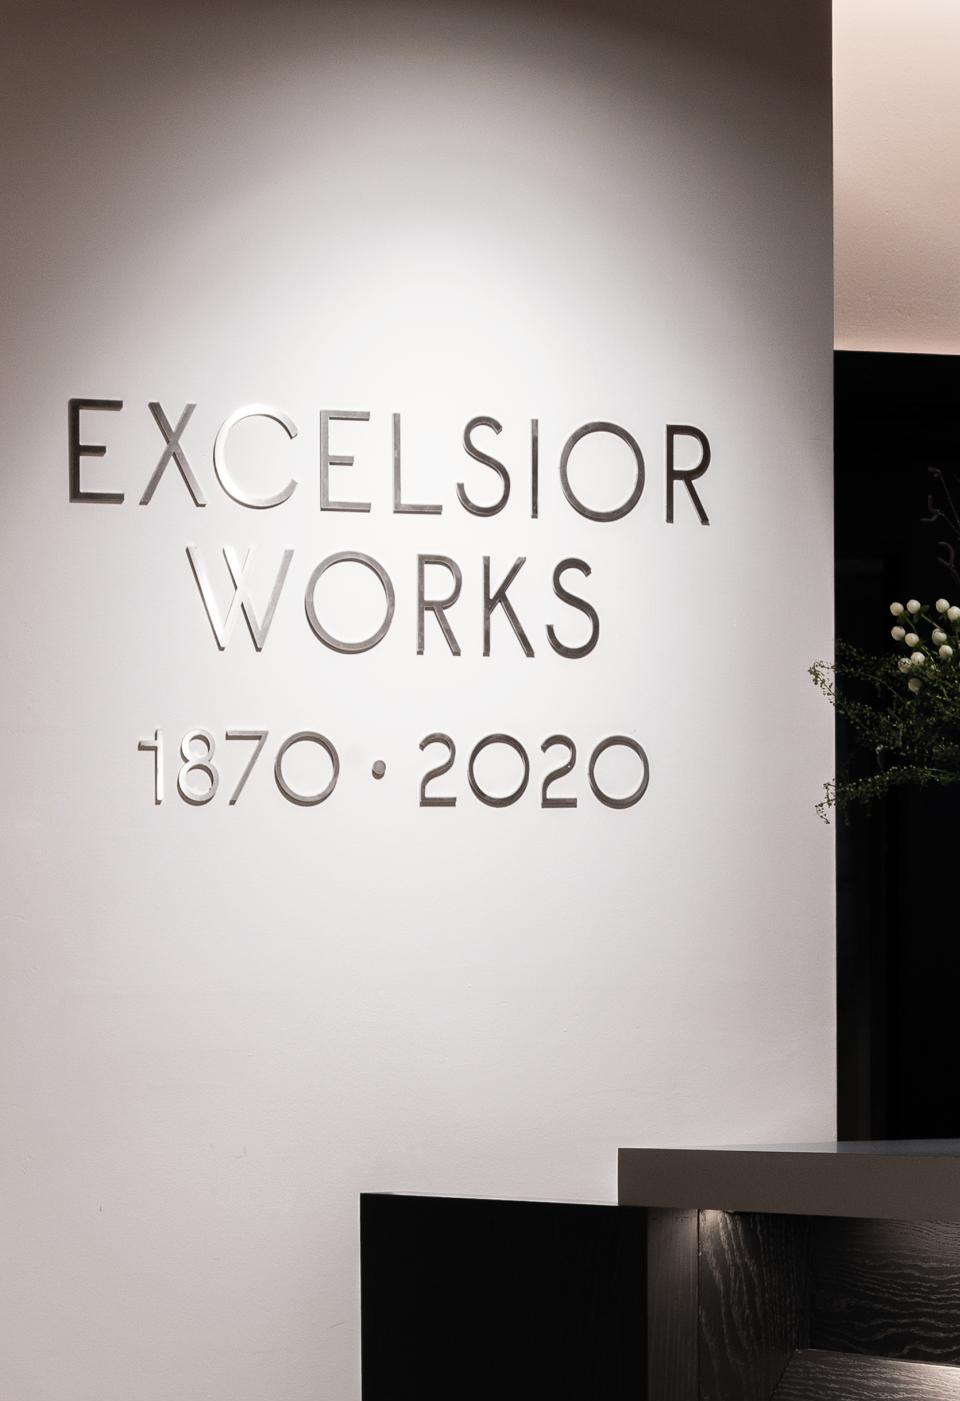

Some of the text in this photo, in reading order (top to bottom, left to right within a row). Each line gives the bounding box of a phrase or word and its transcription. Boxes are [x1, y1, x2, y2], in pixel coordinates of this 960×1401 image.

[68, 397, 711, 526] EXCELSIOR
[185, 544, 600, 659] WORKS
[137, 728, 340, 806] 1870
[419, 731, 650, 809] 2020
